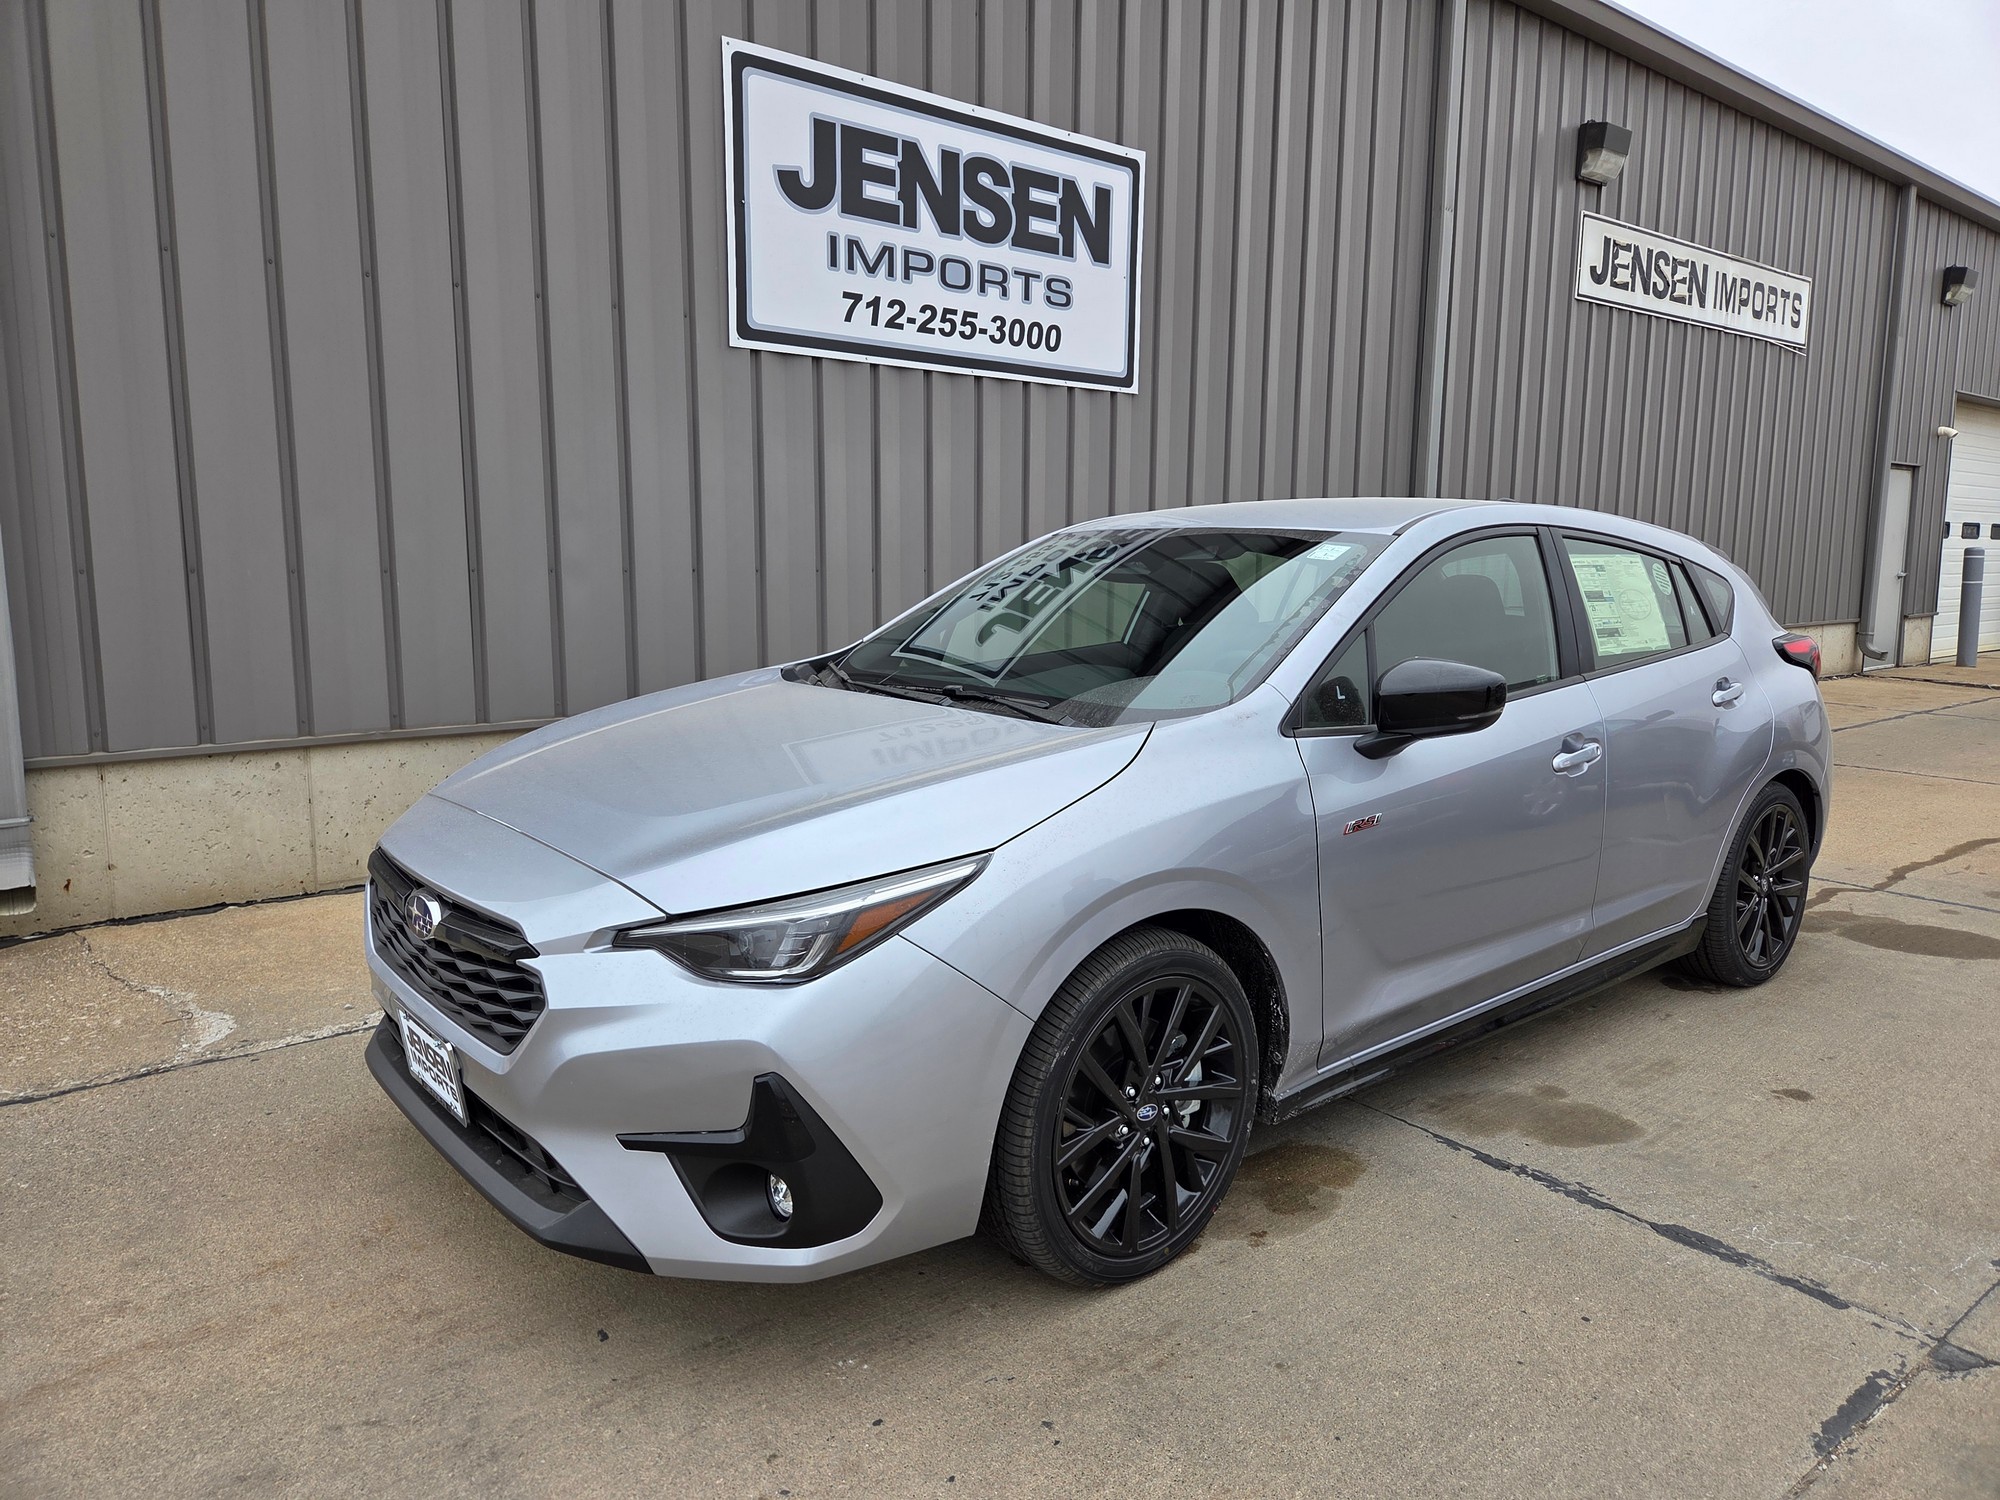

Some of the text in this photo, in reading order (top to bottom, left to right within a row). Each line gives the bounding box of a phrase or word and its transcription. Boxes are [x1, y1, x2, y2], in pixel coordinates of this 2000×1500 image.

[774, 114, 1112, 267] JENSEN
[828, 232, 1073, 310] IMPORTS
[1589, 235, 1802, 329] JENSEN IMPORTS
[841, 290, 1062, 352] 712-255-3000
[406, 1025, 455, 1085] JENSEN
[410, 1047, 459, 1103] IMPORTS
